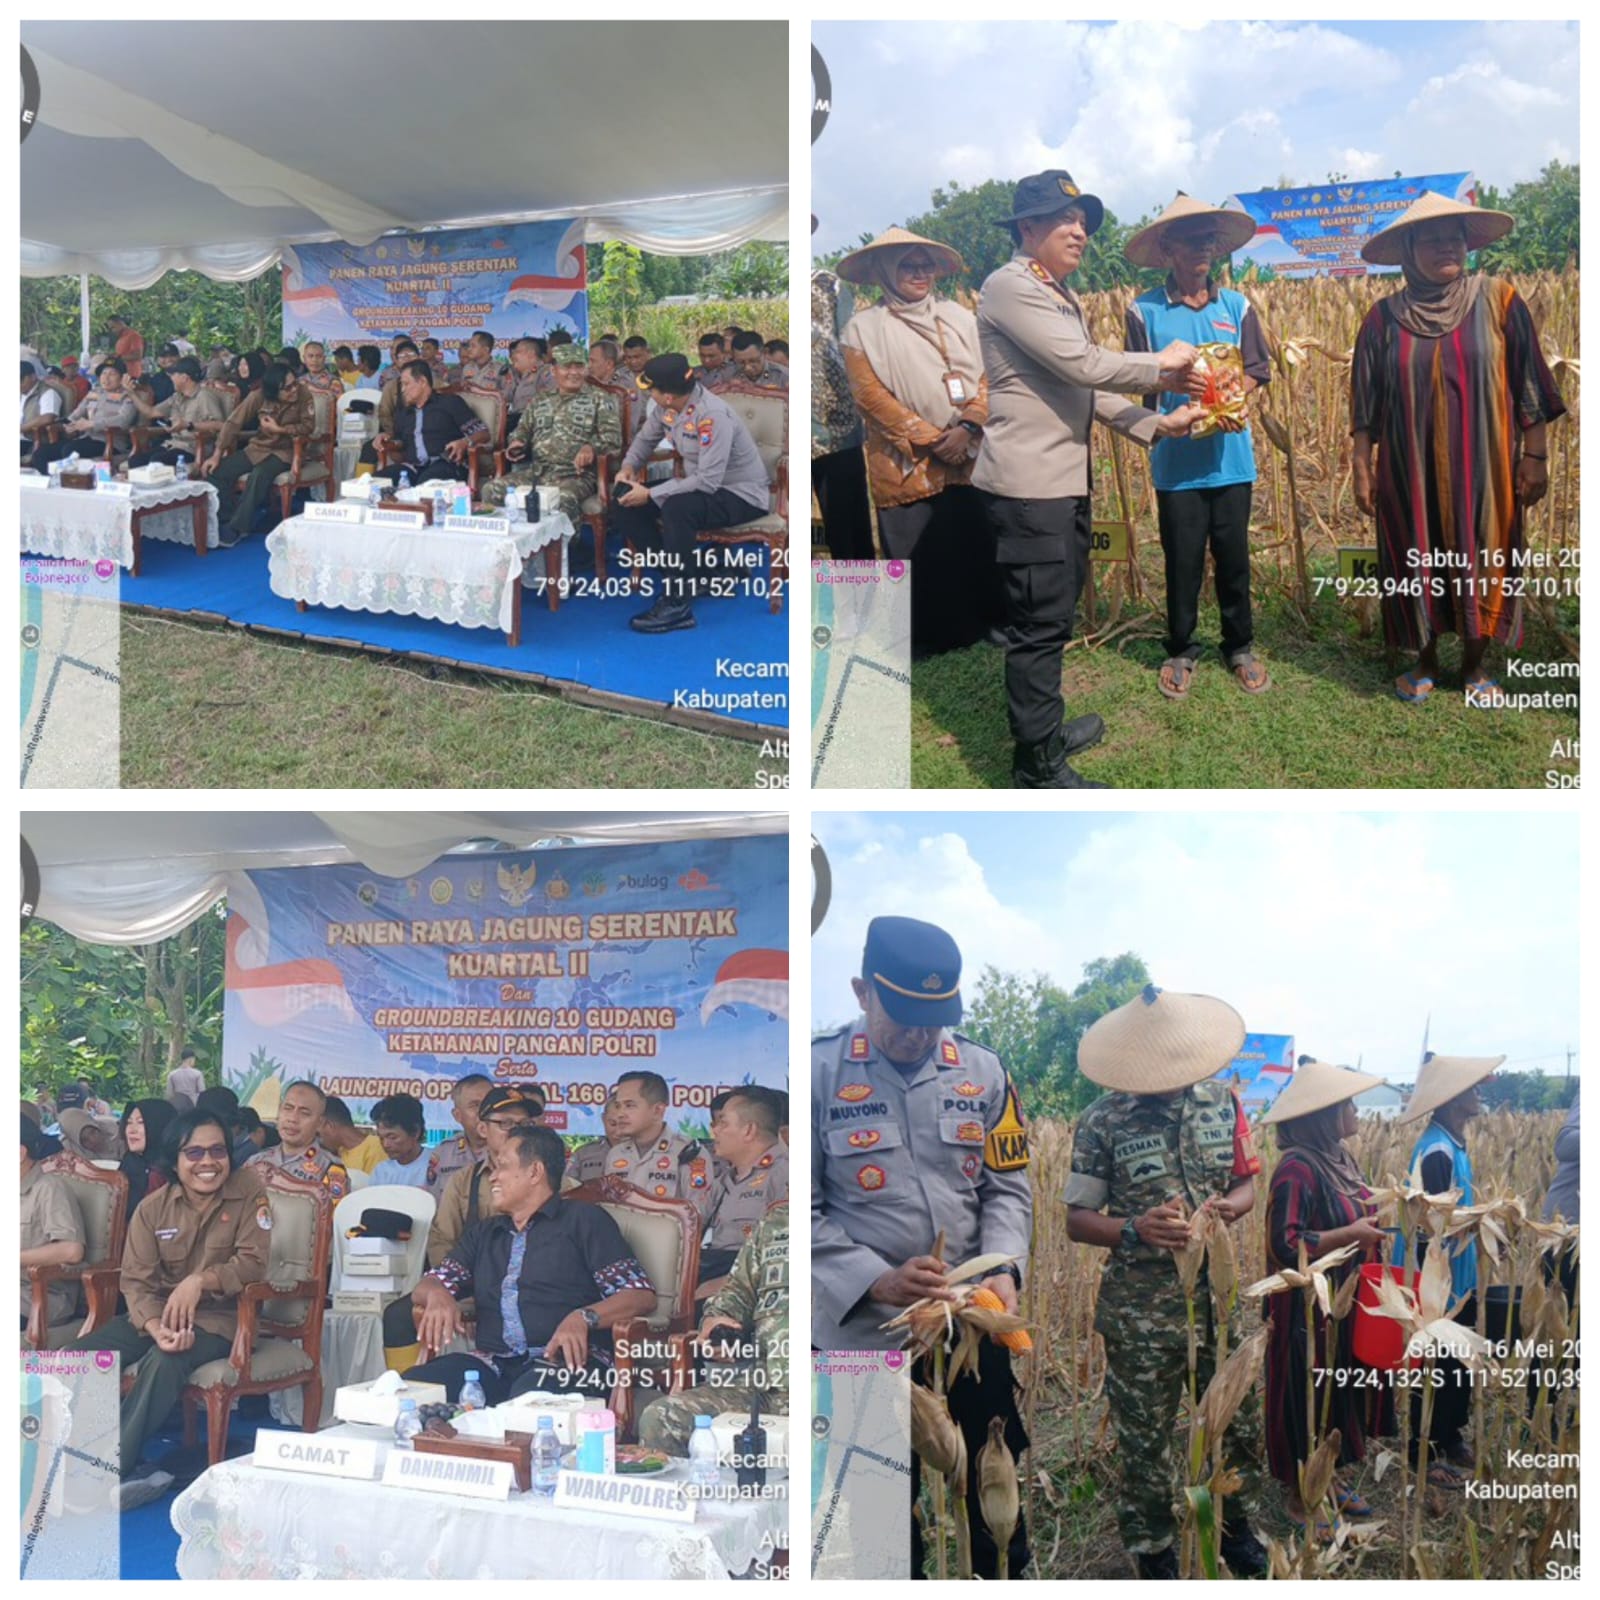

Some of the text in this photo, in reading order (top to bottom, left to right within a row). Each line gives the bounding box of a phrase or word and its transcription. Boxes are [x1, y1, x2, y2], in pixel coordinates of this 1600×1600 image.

[329, 257, 519, 281] PANEN RAYA JAGUNG SERENTAK
[385, 278, 452, 293] KUARTAL II
[450, 303, 493, 315] GUDANG
[314, 507, 349, 518] CAMAT
[626, 874, 668, 890] bulog
[327, 908, 736, 946] PANEN RAYA JAGUNG SERENTAK
[447, 949, 590, 979] KUARTAL II
[500, 982, 534, 1003] Dan
[373, 1007, 675, 1029] GROUNDBREAKING 10 GUDANG
[386, 1033, 656, 1057] KETAHANAN PANGAN POLRI
[318, 1076, 424, 1100] LAUNCHING
[567, 1082, 605, 1106] 166
[829, 1102, 889, 1121] MULYONO
[943, 1098, 990, 1113] POLR
[648, 1171, 676, 1180] POLRI
[277, 1442, 351, 1467] CAMAT
[400, 1456, 497, 1486] DANRANMIL
[565, 1476, 689, 1513] WAKAPOLRES
